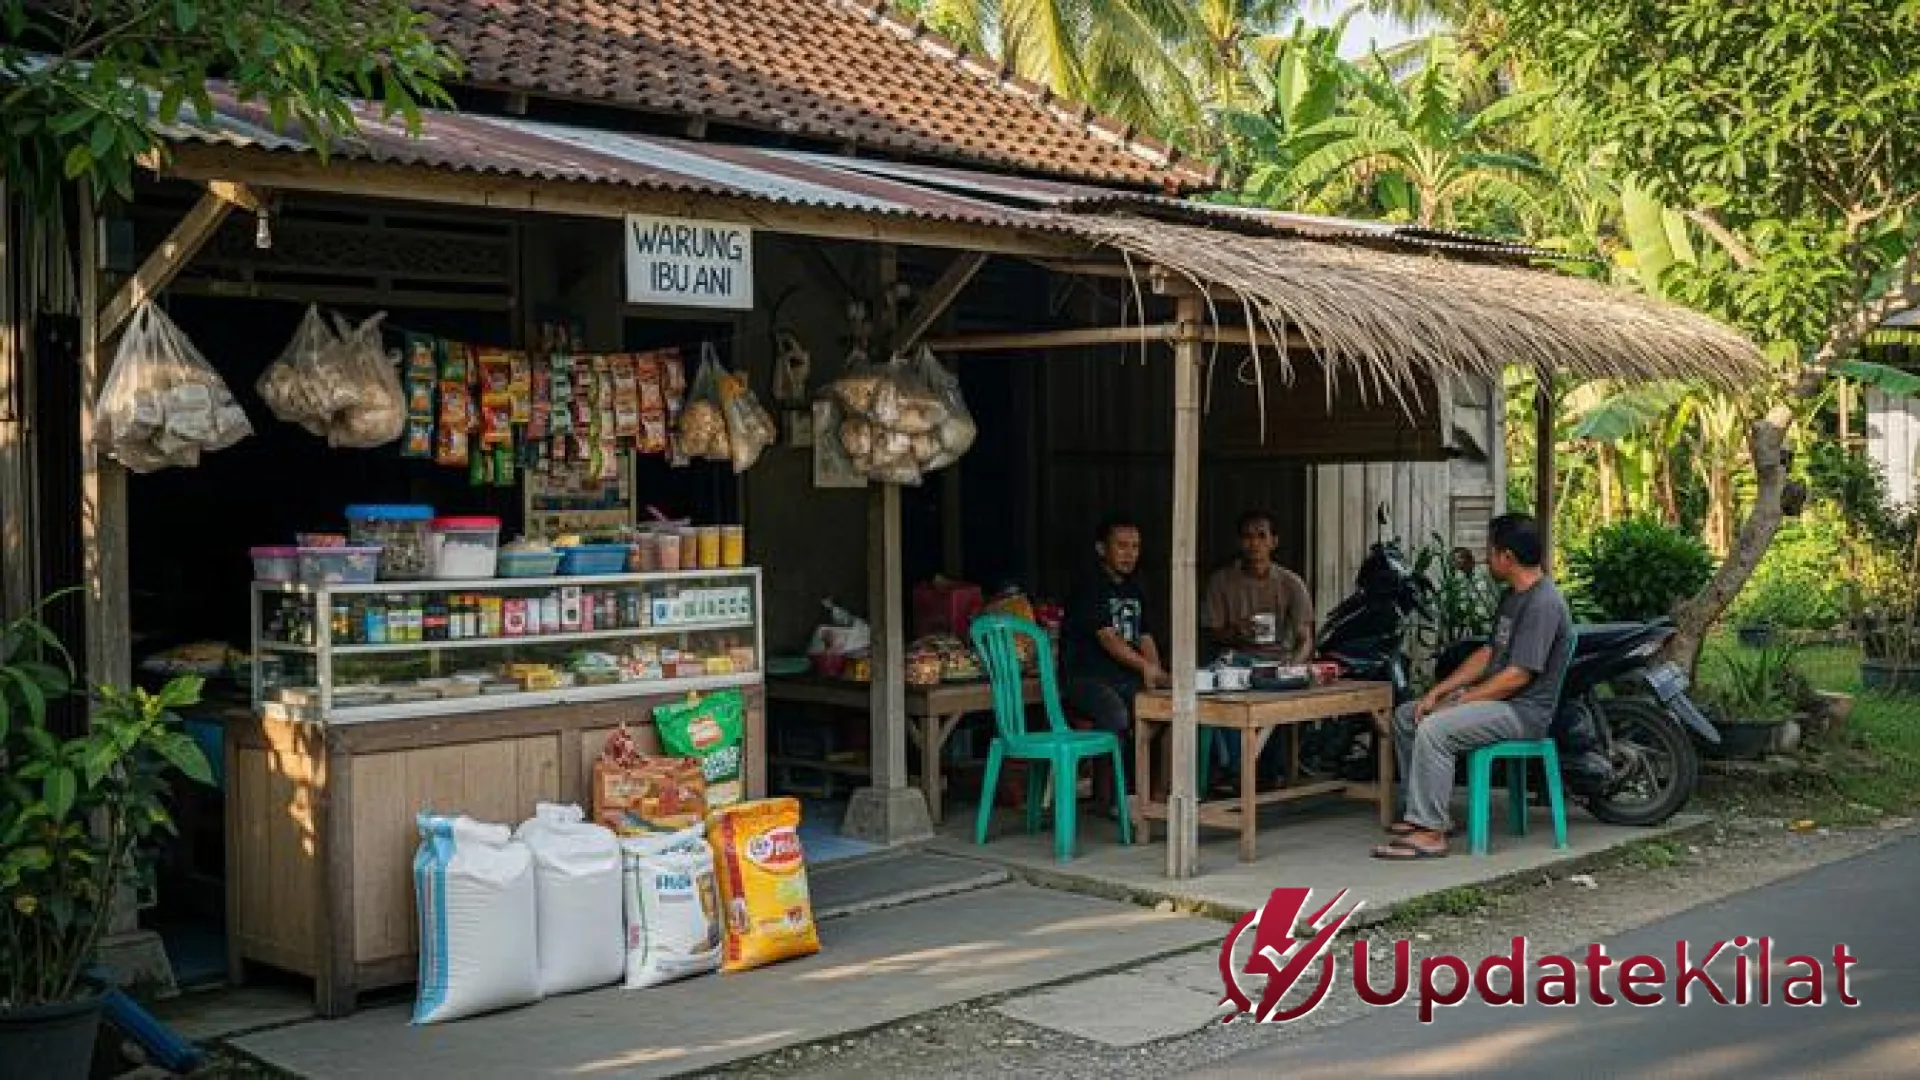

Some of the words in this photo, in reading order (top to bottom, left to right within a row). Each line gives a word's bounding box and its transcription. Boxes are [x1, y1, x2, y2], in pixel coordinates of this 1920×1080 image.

[632, 221, 743, 261] WARUNG
[650, 261, 690, 293] IBU
[692, 264, 732, 297] ANI
